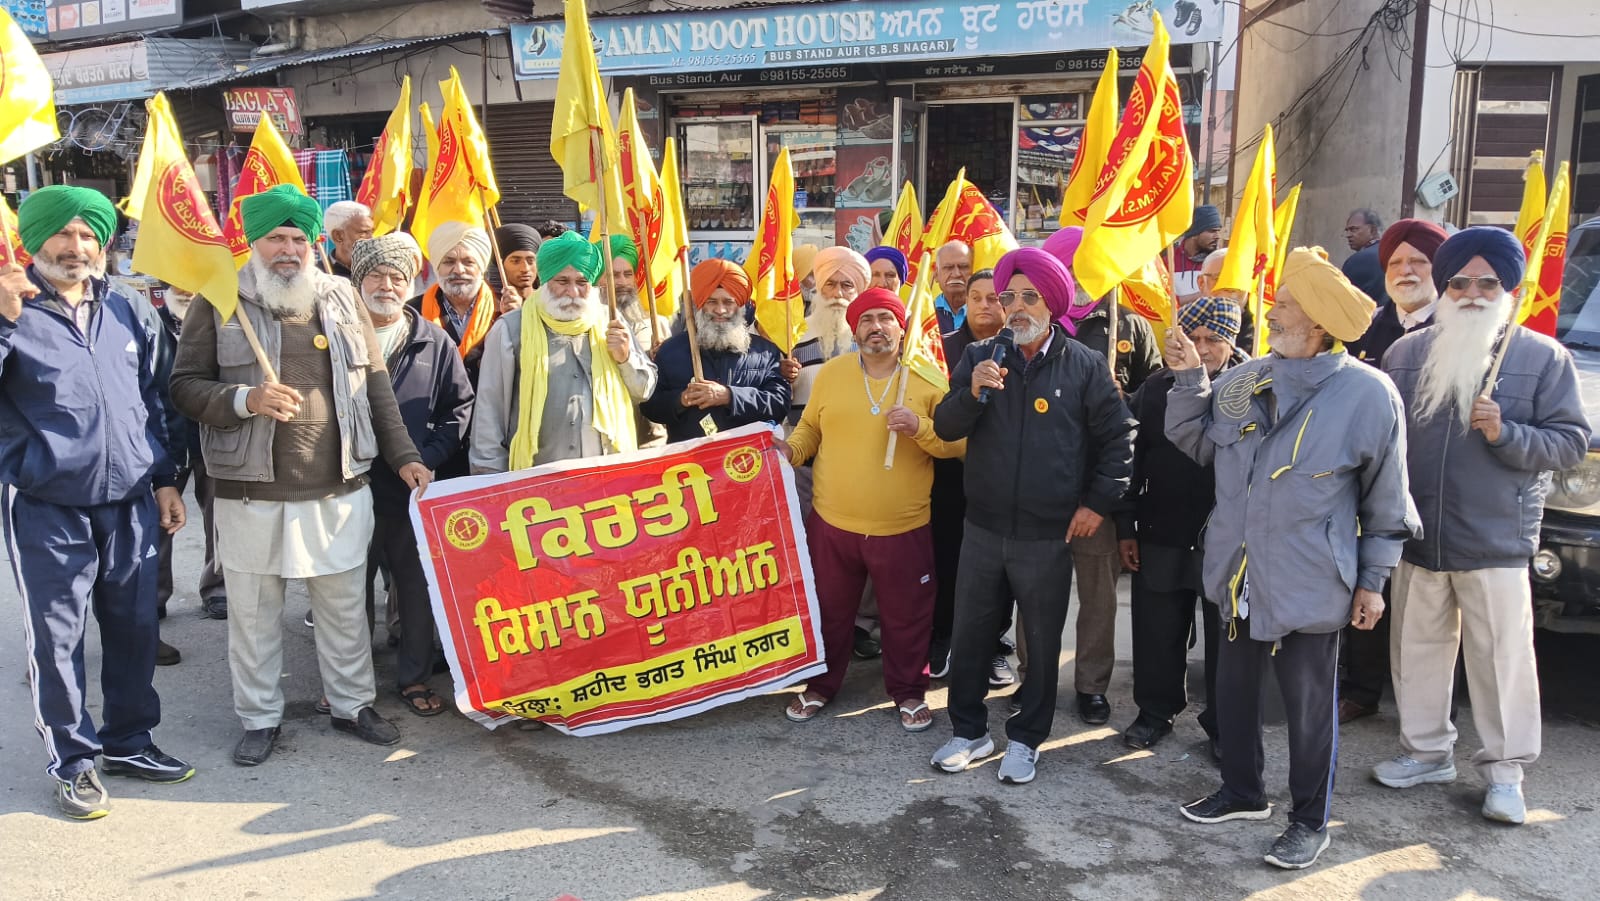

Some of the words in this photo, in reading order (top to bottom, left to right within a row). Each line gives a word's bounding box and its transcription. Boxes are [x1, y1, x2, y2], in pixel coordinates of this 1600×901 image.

[605, 22, 682, 57] AMAN
[688, 17, 767, 52] BOOT
[774, 10, 876, 47] HOUSE
[880, 7, 945, 38] ਅਮਨ
[960, 4, 1000, 50] ਬੂਟ
[688, 53, 757, 67] 98155-25565
[770, 51, 792, 61] BUS
[796, 49, 833, 60] STAND
[837, 46, 861, 57] AUR
[864, 44, 899, 57] (S.B.S
[904, 40, 949, 53] NAGAR)
[1068, 57, 1141, 70] 98155556
[650, 75, 673, 85] Bus
[677, 72, 717, 84] Stand,
[720, 72, 743, 81] Aur
[769, 67, 847, 81] 98155-25565
[223, 91, 279, 111] BAGLA
[500, 462, 720, 572] ਕਿਰਤੀ
[473, 589, 606, 663] ਕਿਸਾਨ
[618, 540, 780, 646] ਯੂਨੀਅਨ
[570, 672, 627, 703] ਸ਼ਹੀਦ
[635, 659, 685, 689] ਭਗਤ
[693, 643, 736, 673] ਸਿੰਘ
[743, 628, 790, 658] ਨਗਰ
